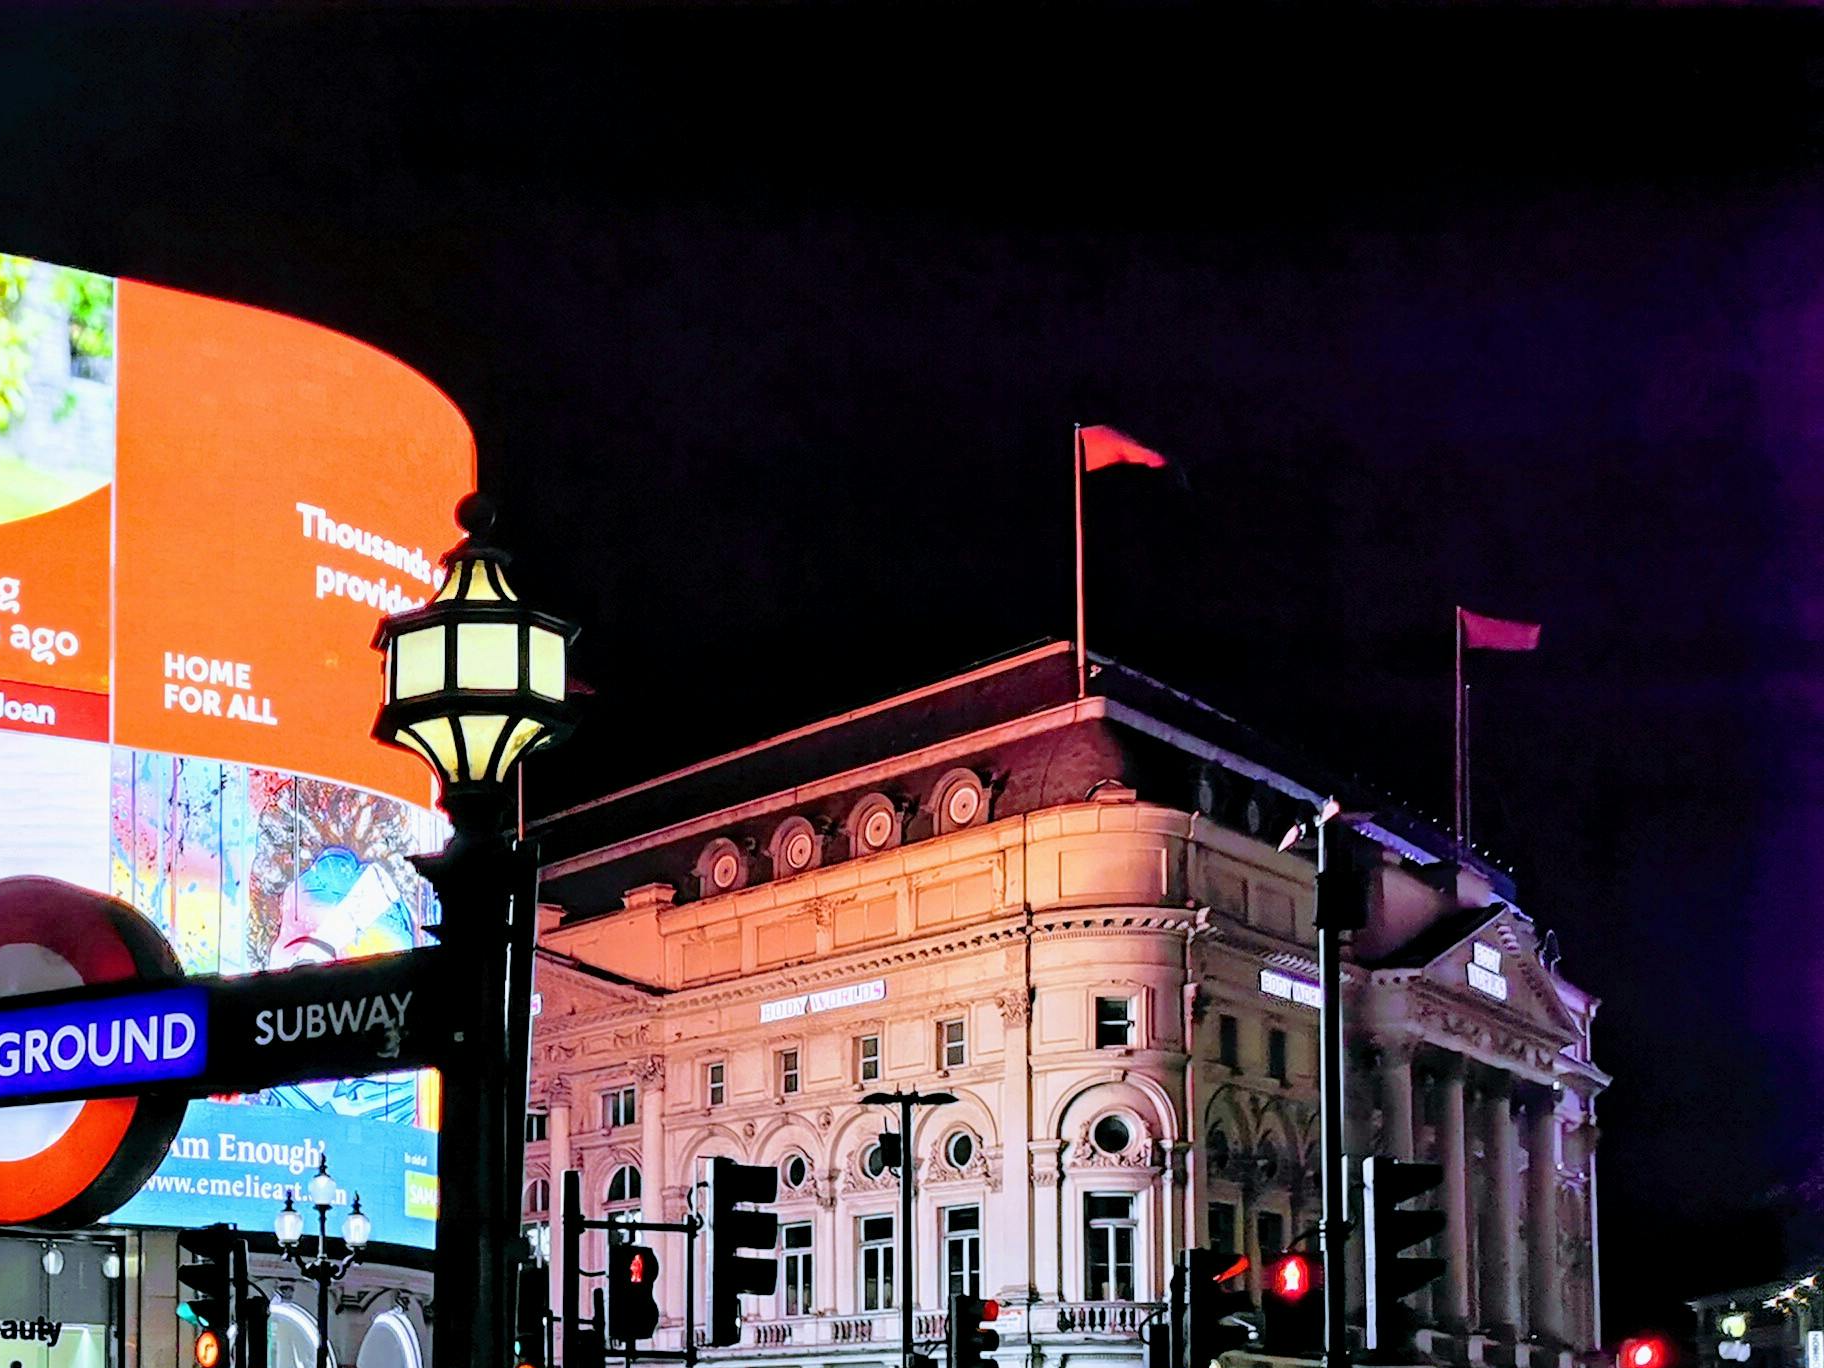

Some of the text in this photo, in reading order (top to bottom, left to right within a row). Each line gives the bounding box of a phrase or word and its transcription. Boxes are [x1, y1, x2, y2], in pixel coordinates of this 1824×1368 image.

[296, 502, 431, 584] Thousands
[10, 621, 79, 665] ago
[164, 651, 251, 689] HOME
[164, 683, 278, 725] FOR ALL
[254, 991, 412, 1046] SUBWAY
[764, 982, 883, 1019] BODY WORLDS
